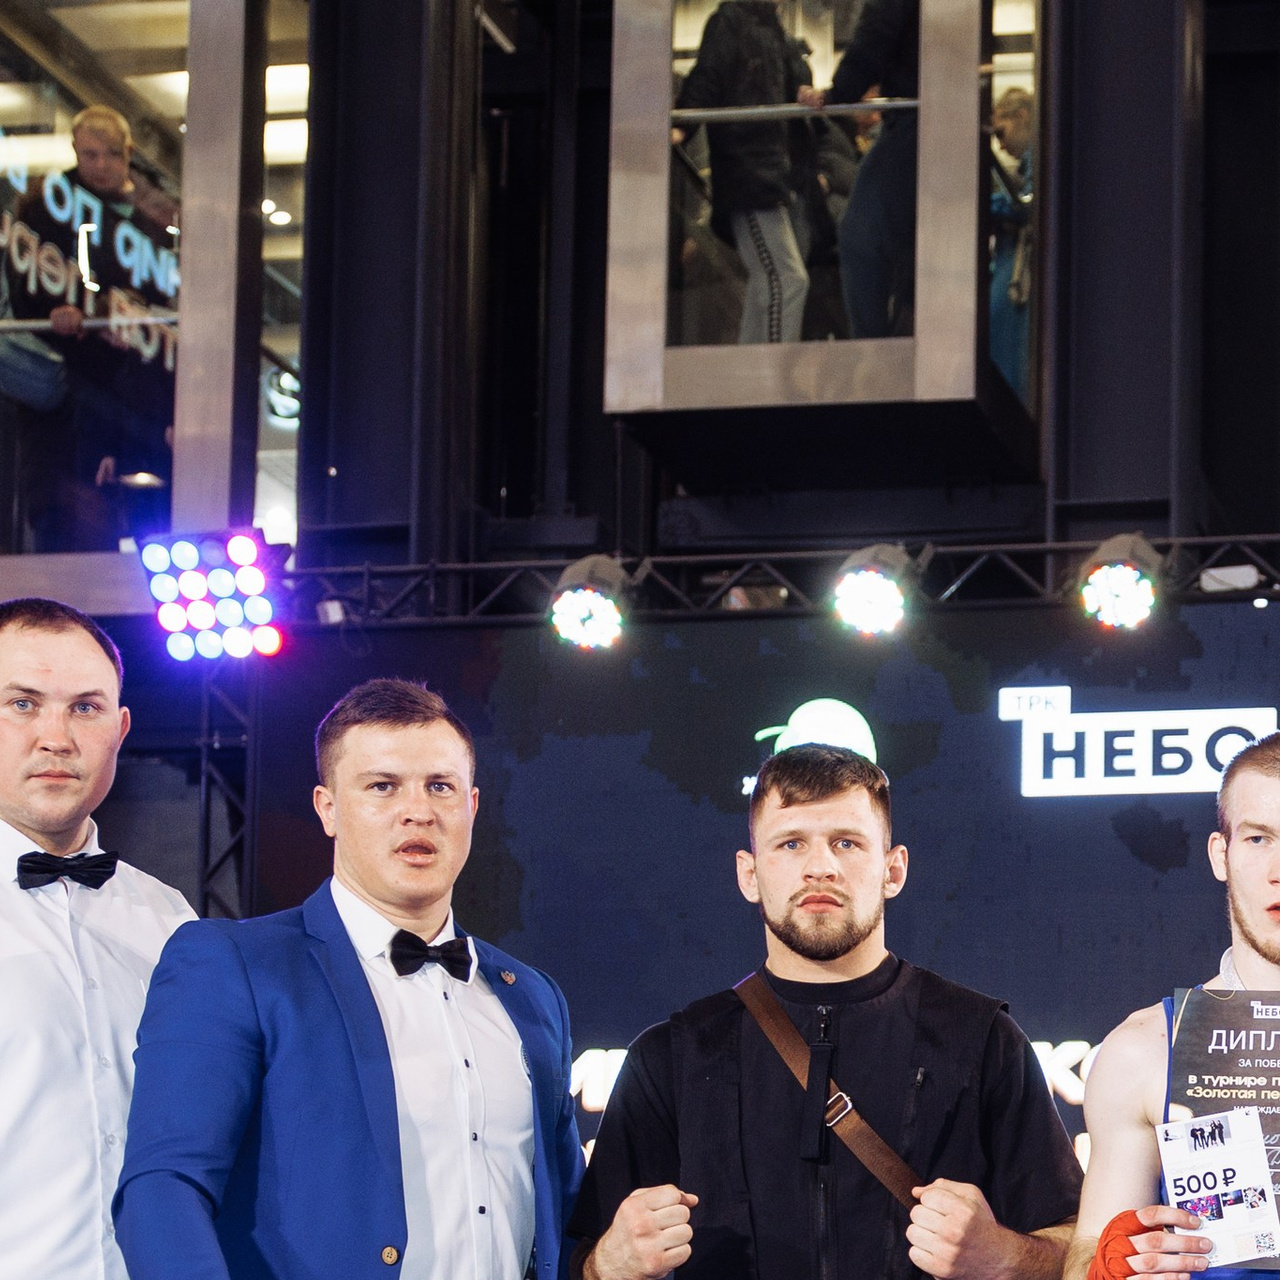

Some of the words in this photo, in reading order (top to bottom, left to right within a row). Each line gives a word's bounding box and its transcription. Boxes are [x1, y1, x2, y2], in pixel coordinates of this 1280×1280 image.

[1238, 1059, 1253, 1068] ЗА
[1202, 1075, 1268, 1088] турнире
[1186, 1086, 1257, 1100] «Золотая
[1173, 1171, 1218, 1198] 500
